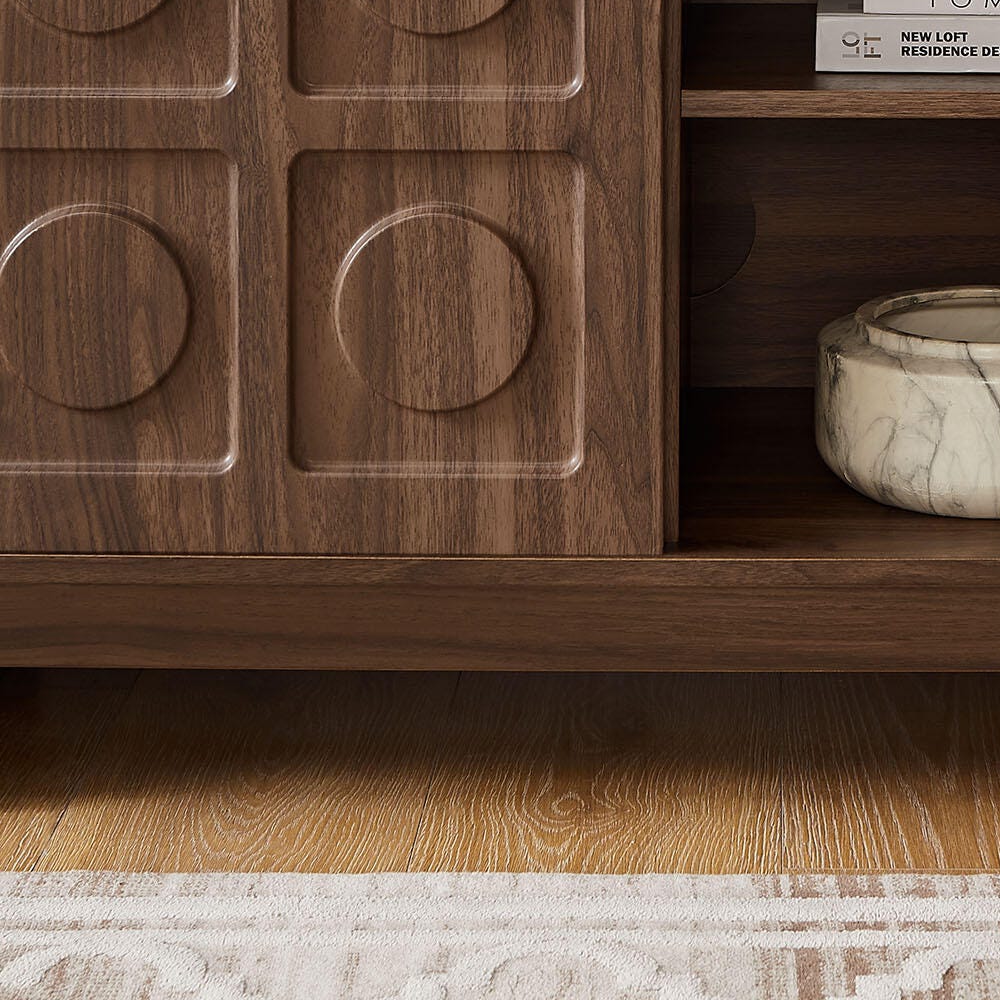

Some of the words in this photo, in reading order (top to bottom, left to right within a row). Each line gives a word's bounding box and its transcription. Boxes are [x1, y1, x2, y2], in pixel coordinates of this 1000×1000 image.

[901, 31, 933, 43] NEW
[935, 31, 969, 43] LOFT
[901, 45, 979, 58] RESIDENCE
